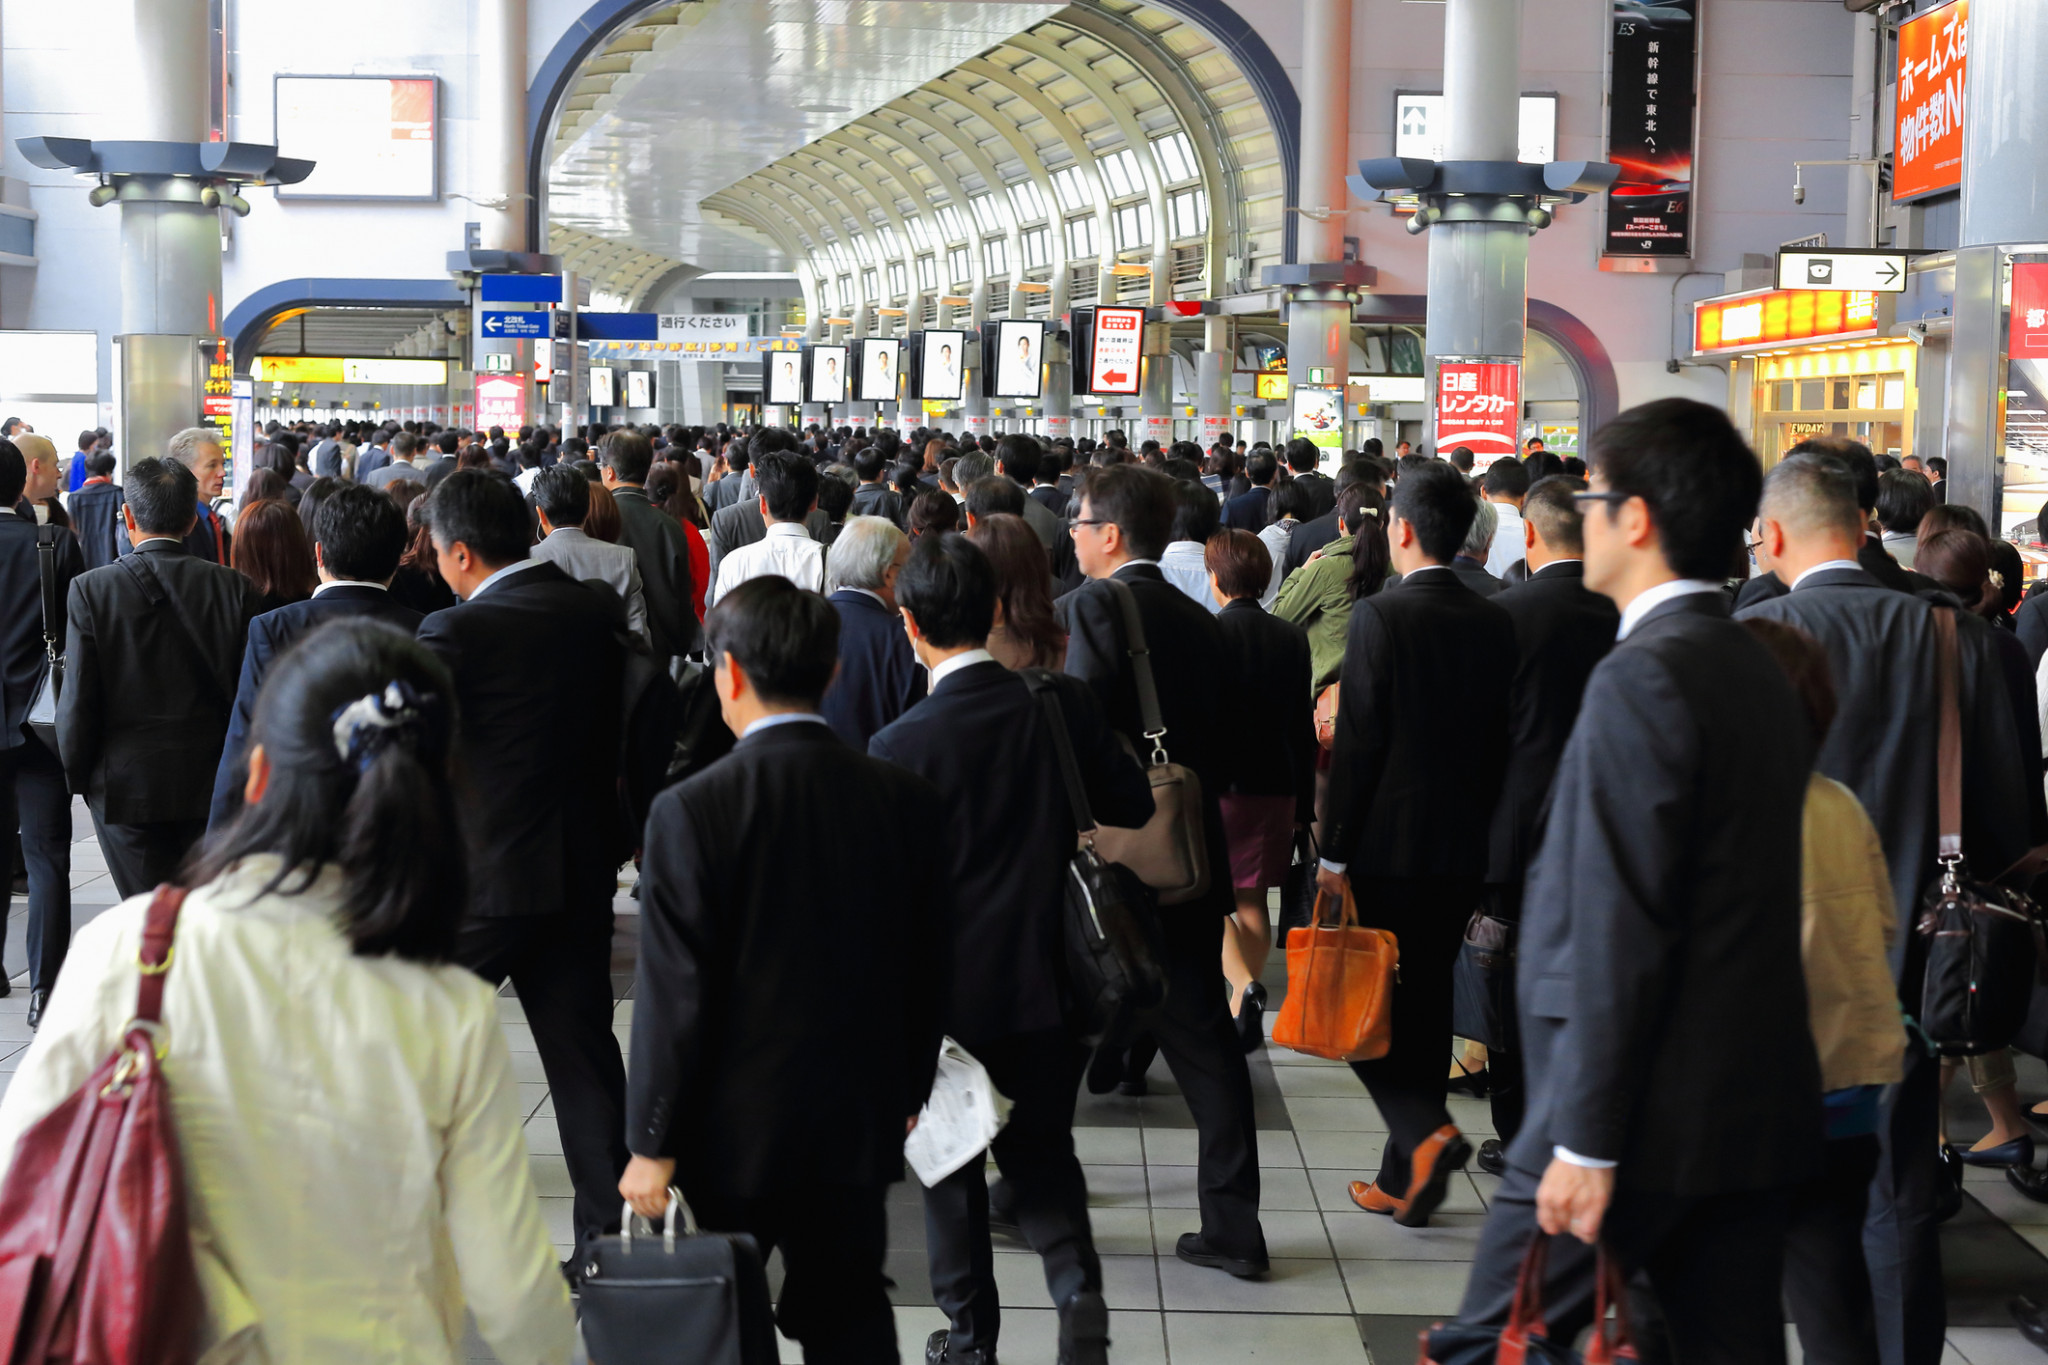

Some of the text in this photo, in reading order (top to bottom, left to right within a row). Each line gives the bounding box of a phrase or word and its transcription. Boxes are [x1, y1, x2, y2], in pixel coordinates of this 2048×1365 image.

[1617, 22, 1635, 36] E5
[1901, 11, 1968, 102] ホームズは
[1644, 41, 1660, 154] 新幹線で東北へ。
[1901, 67, 1966, 167] 物件数N
[1665, 200, 1684, 213] E6
[1641, 240, 1652, 248] JR
[660, 317, 737, 329] 通行ください
[1443, 372, 1477, 391] 日産
[1442, 394, 1515, 413] レンタカー
[1790, 423, 1825, 434] EWDAY
